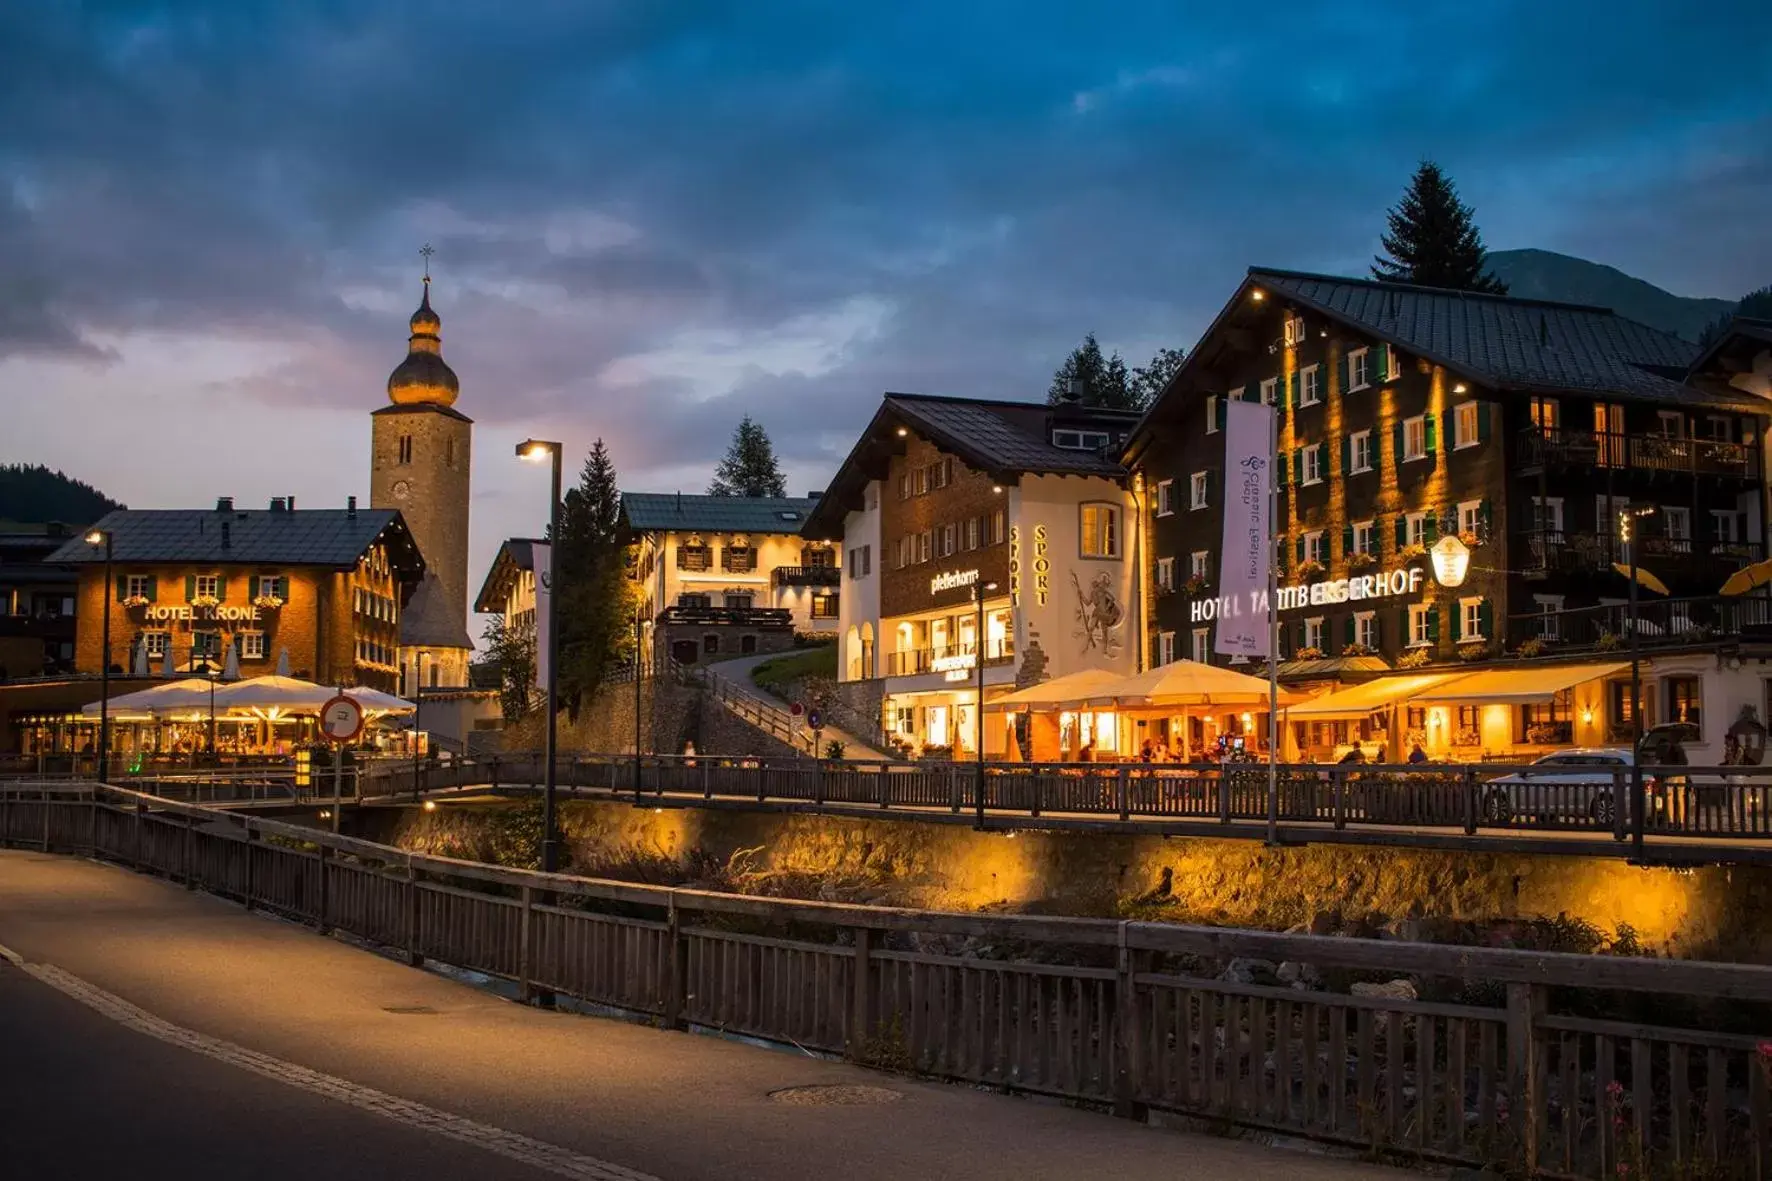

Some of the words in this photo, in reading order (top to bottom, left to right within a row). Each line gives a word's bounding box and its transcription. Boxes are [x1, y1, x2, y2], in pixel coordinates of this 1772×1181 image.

[1009, 526, 1019, 607] SPORT
[1034, 525, 1050, 606] SPORT
[144, 606, 199, 620] HOTEL
[204, 606, 262, 620] KRONE
[1191, 593, 1242, 622] HOTEL
